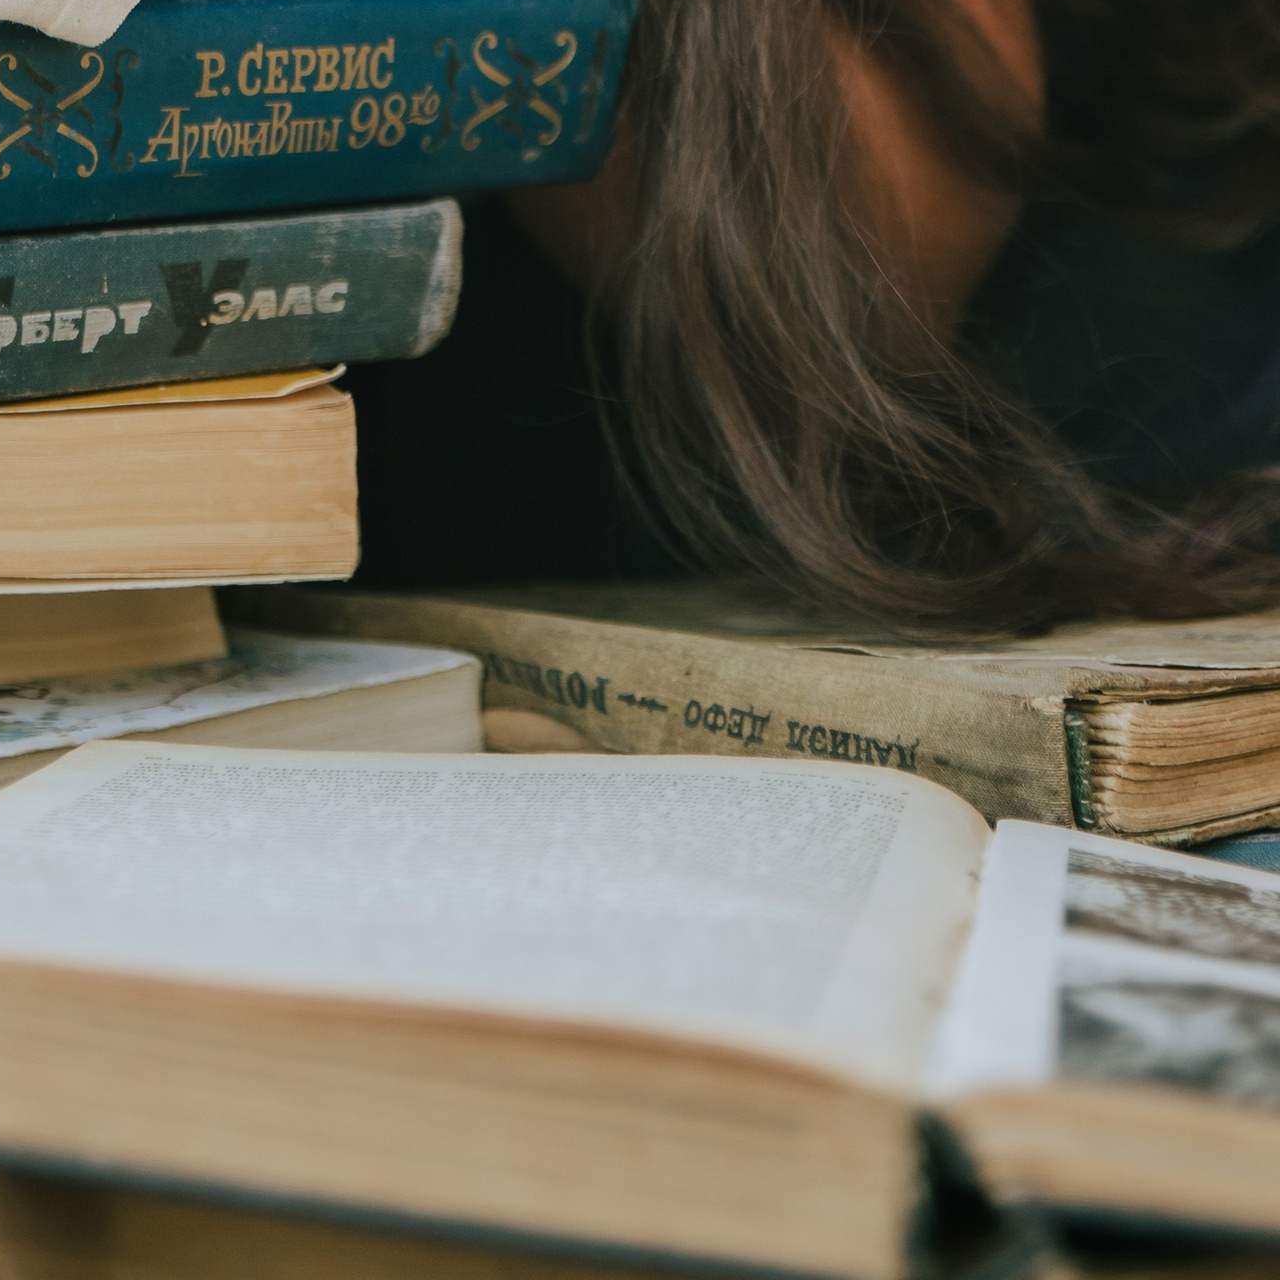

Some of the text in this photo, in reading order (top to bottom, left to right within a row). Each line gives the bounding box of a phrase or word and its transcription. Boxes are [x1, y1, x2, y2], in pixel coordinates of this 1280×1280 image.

[194, 35, 396, 98] Р. СЕРВИС
[682, 695, 773, 746] ДЕФО
[786, 720, 920, 773] ДАНИЭЛ
